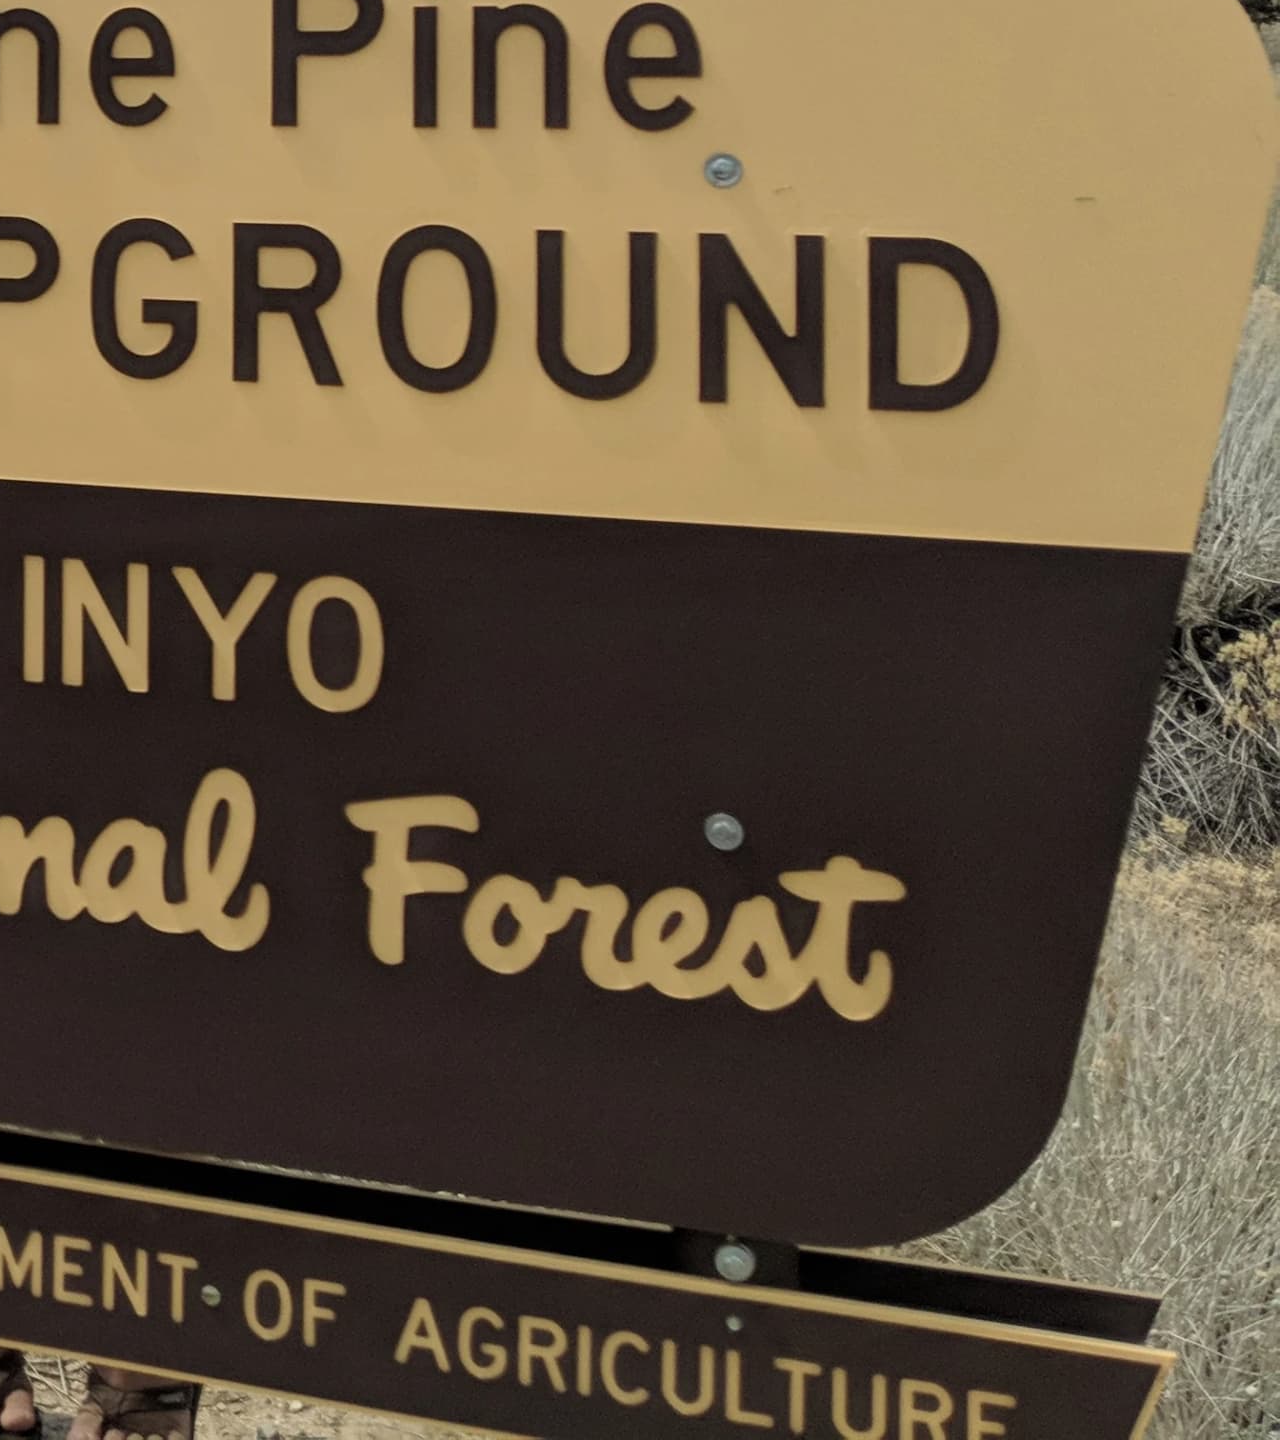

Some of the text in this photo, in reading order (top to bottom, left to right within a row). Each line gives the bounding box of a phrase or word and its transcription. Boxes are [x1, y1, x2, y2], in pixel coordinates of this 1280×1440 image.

[23, 555, 384, 713] INYO
[345, 795, 906, 1022] Forest
[243, 1269, 347, 1348] OF
